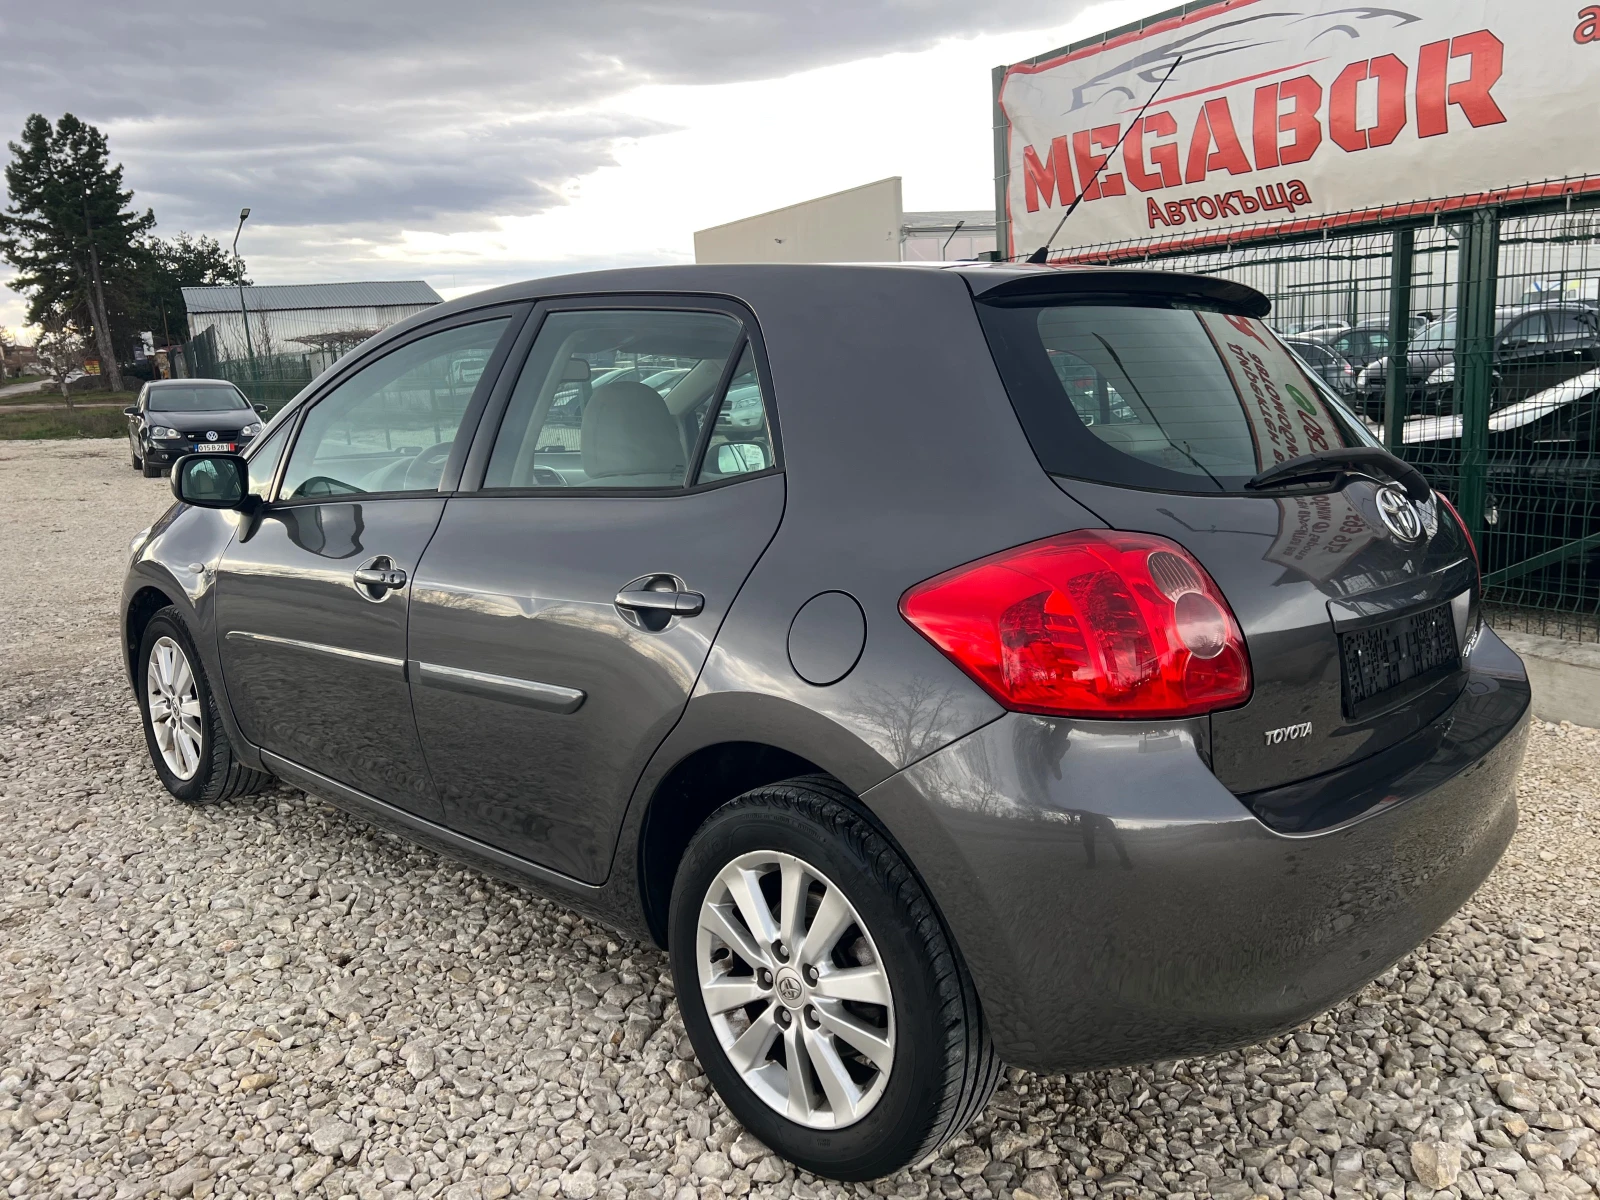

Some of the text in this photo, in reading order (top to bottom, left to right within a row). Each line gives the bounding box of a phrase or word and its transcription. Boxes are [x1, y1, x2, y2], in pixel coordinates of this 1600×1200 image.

[1023, 29, 1507, 212] MEGABOR
[1146, 179, 1312, 229] Автокъща
[1264, 721, 1313, 746] TOYOTA
